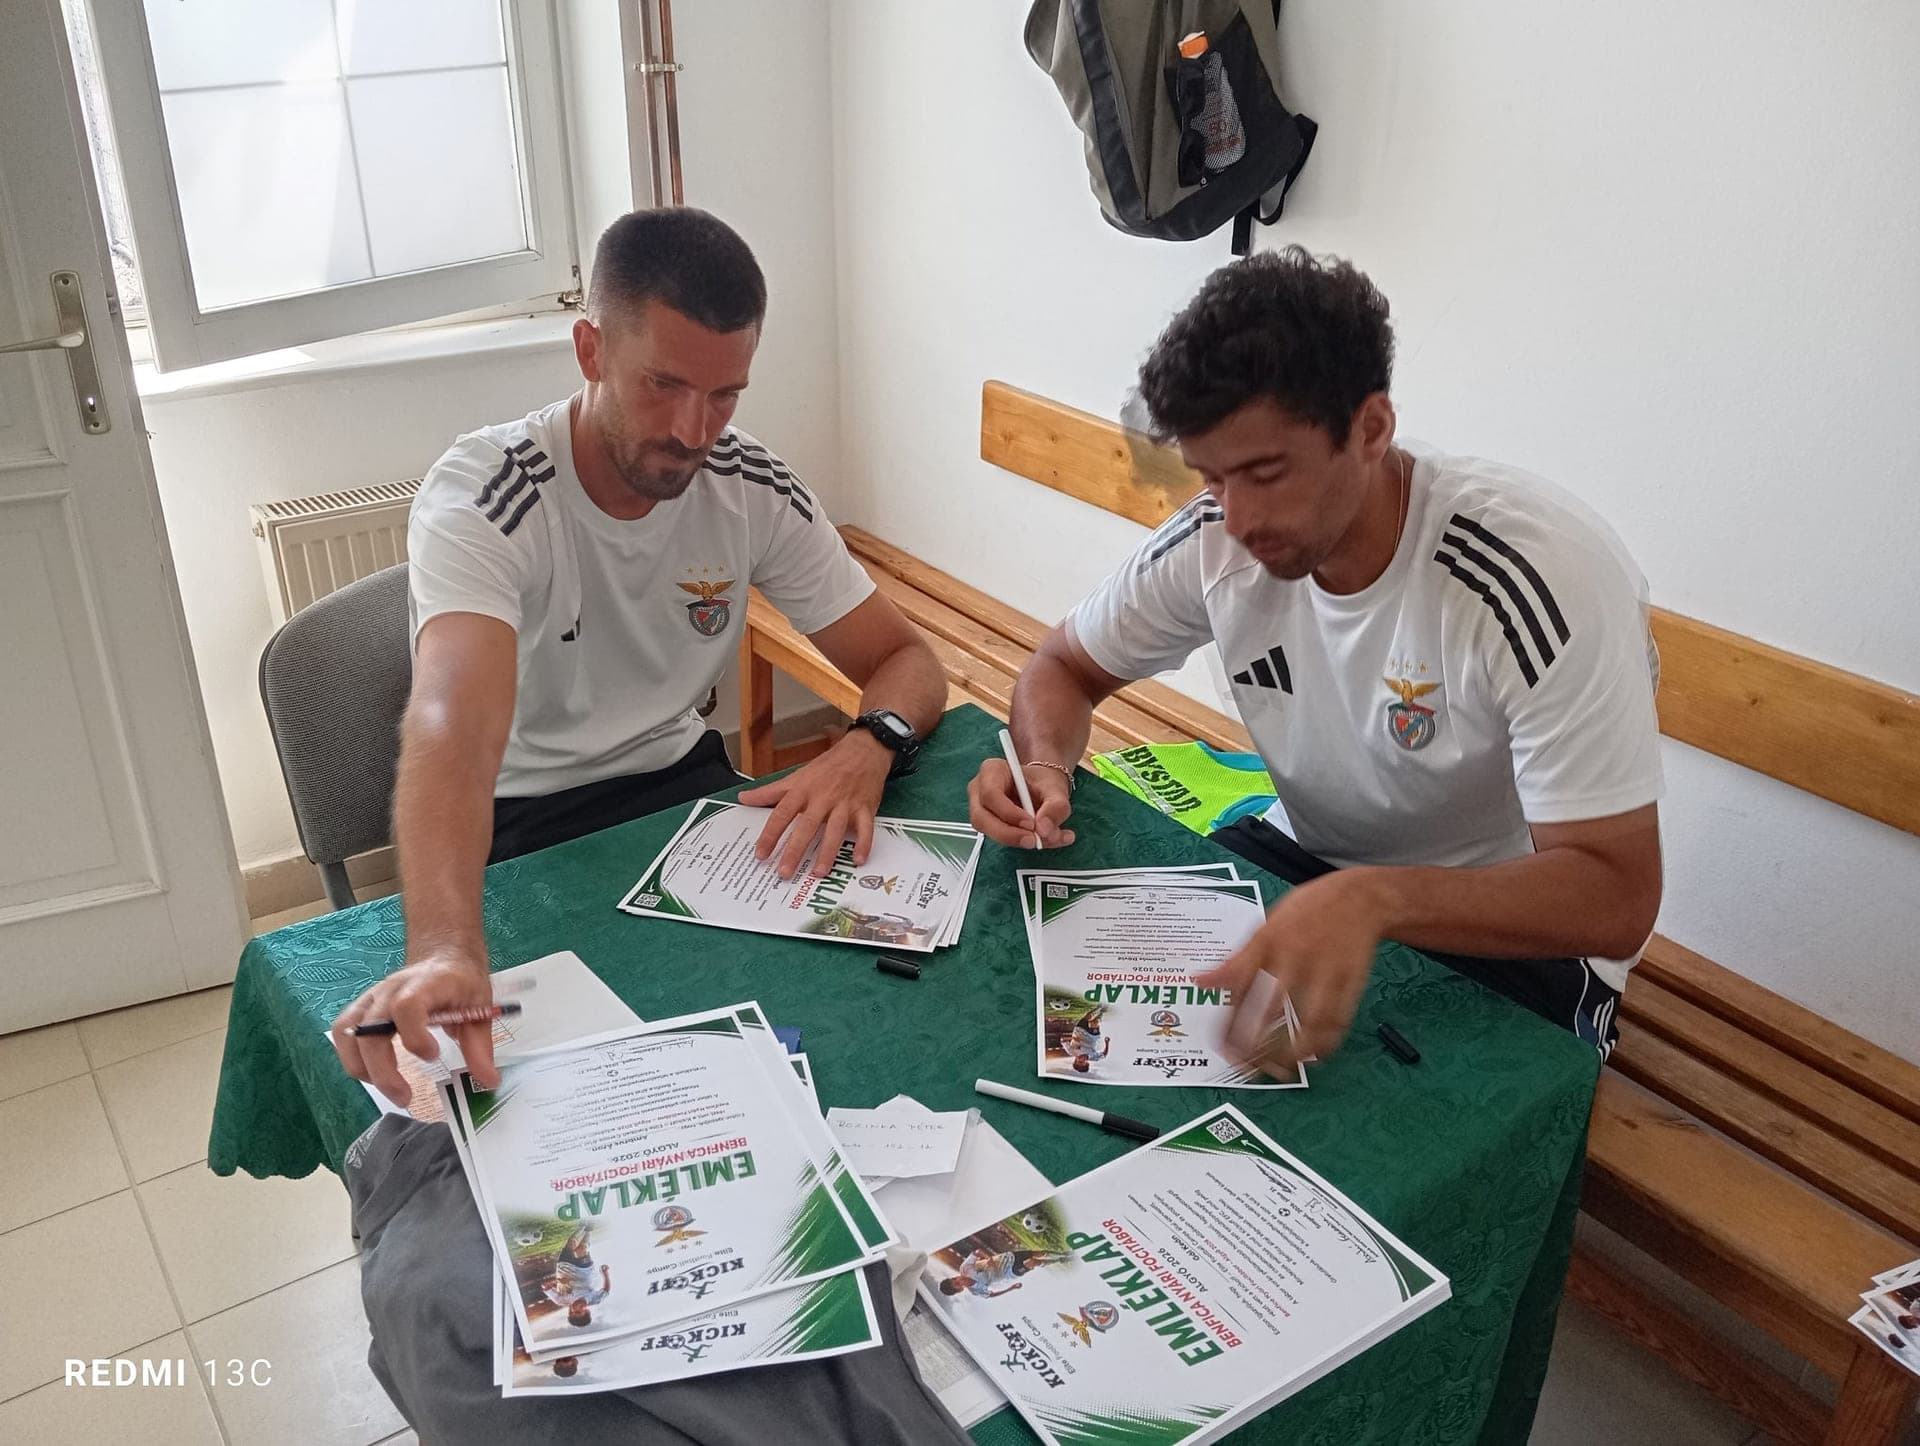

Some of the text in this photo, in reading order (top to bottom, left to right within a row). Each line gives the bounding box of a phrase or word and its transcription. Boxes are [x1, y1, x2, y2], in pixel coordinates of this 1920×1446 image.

[1115, 745, 1202, 813] BYSTAR
[1082, 983, 1236, 1008] EMLÉKLAP
[1086, 972, 1187, 983] NYÁRI FOCITÁBOR
[1131, 1057, 1209, 1067] KICKOFF
[549, 1136, 748, 1192] BENFICA NYÁRI FOCITÁBOR
[557, 1150, 756, 1222] EMLÉKLAP
[642, 1256, 747, 1296] KICKOFF
[1102, 1218, 1243, 1349] BENFICA NYÁRI FOCITÁBOR
[1158, 1247, 1209, 1293] ALGYŐ 2026
[1067, 1231, 1224, 1367] EMLÉKLAP
[637, 1322, 750, 1352] KICKOFF
[1021, 1315, 1041, 1337] Camps
[996, 1323, 1065, 1389] KICKOFF
[1060, 1358, 1077, 1375] Elite
